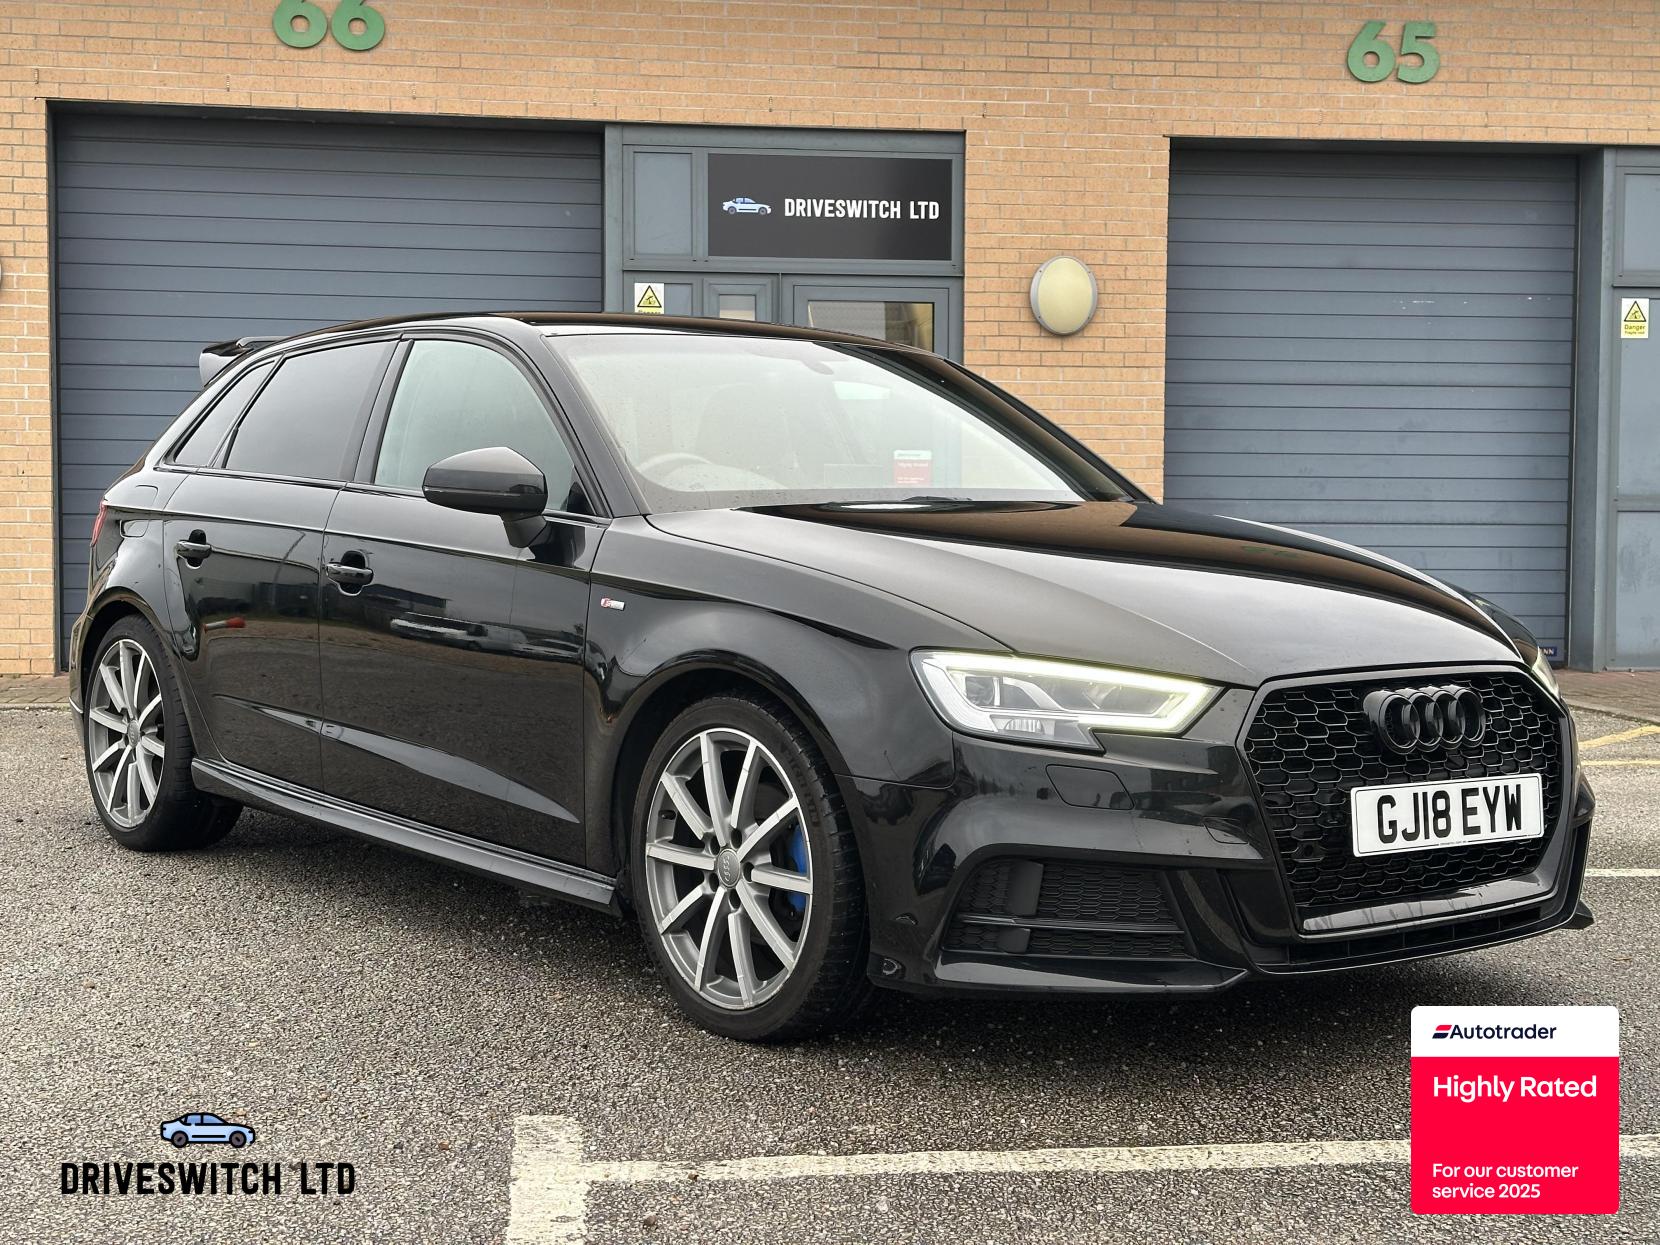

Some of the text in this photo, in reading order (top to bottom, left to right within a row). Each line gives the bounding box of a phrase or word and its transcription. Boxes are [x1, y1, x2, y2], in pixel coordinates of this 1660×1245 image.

[272, 0, 385, 52] 66
[1347, 20, 1440, 84] 65
[784, 198, 940, 220] DRIVESWITCH LTD
[1377, 784, 1522, 844] GJ18 EYW
